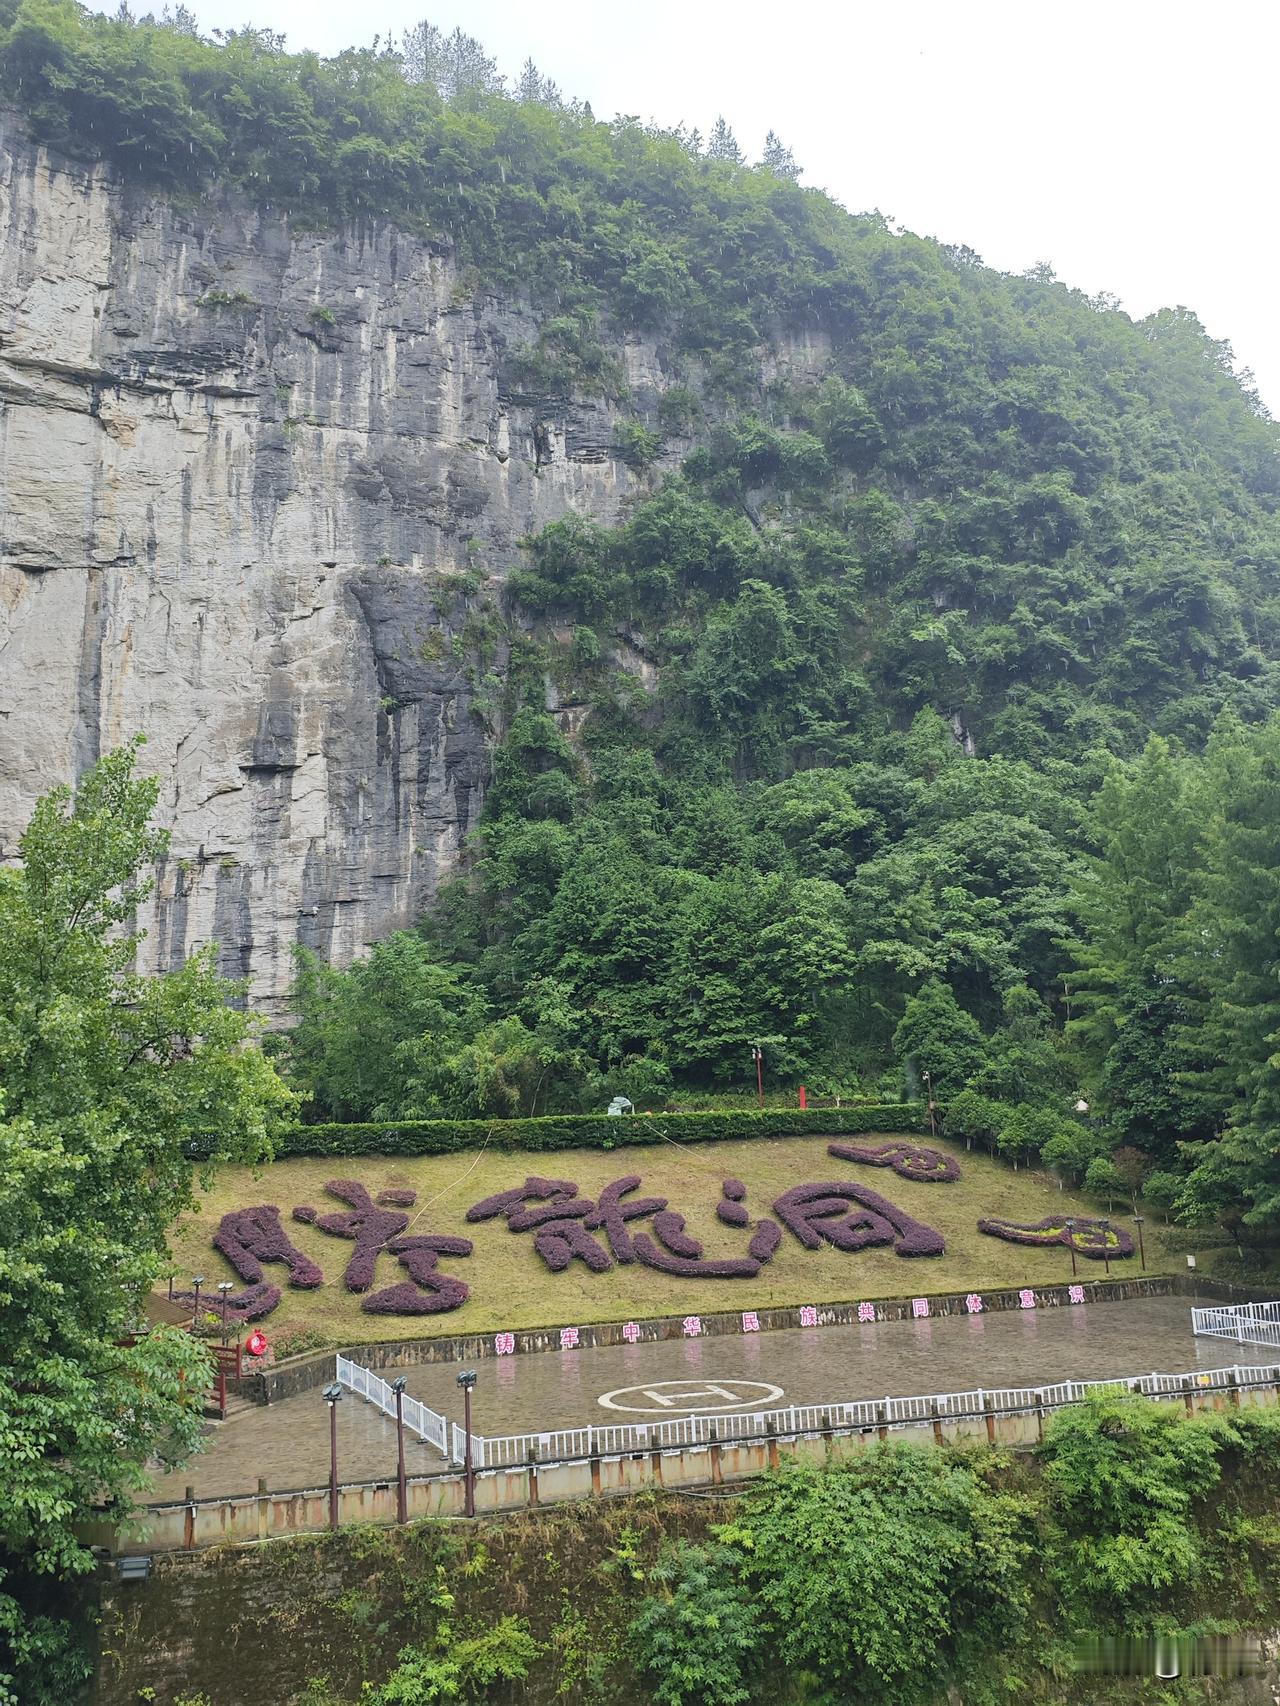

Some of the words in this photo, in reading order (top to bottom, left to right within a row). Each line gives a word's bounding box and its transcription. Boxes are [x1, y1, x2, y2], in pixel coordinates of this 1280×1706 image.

[495, 1285, 1086, 1355] 铸牢中华民族共同体意识
[642, 1385, 742, 1406] H
